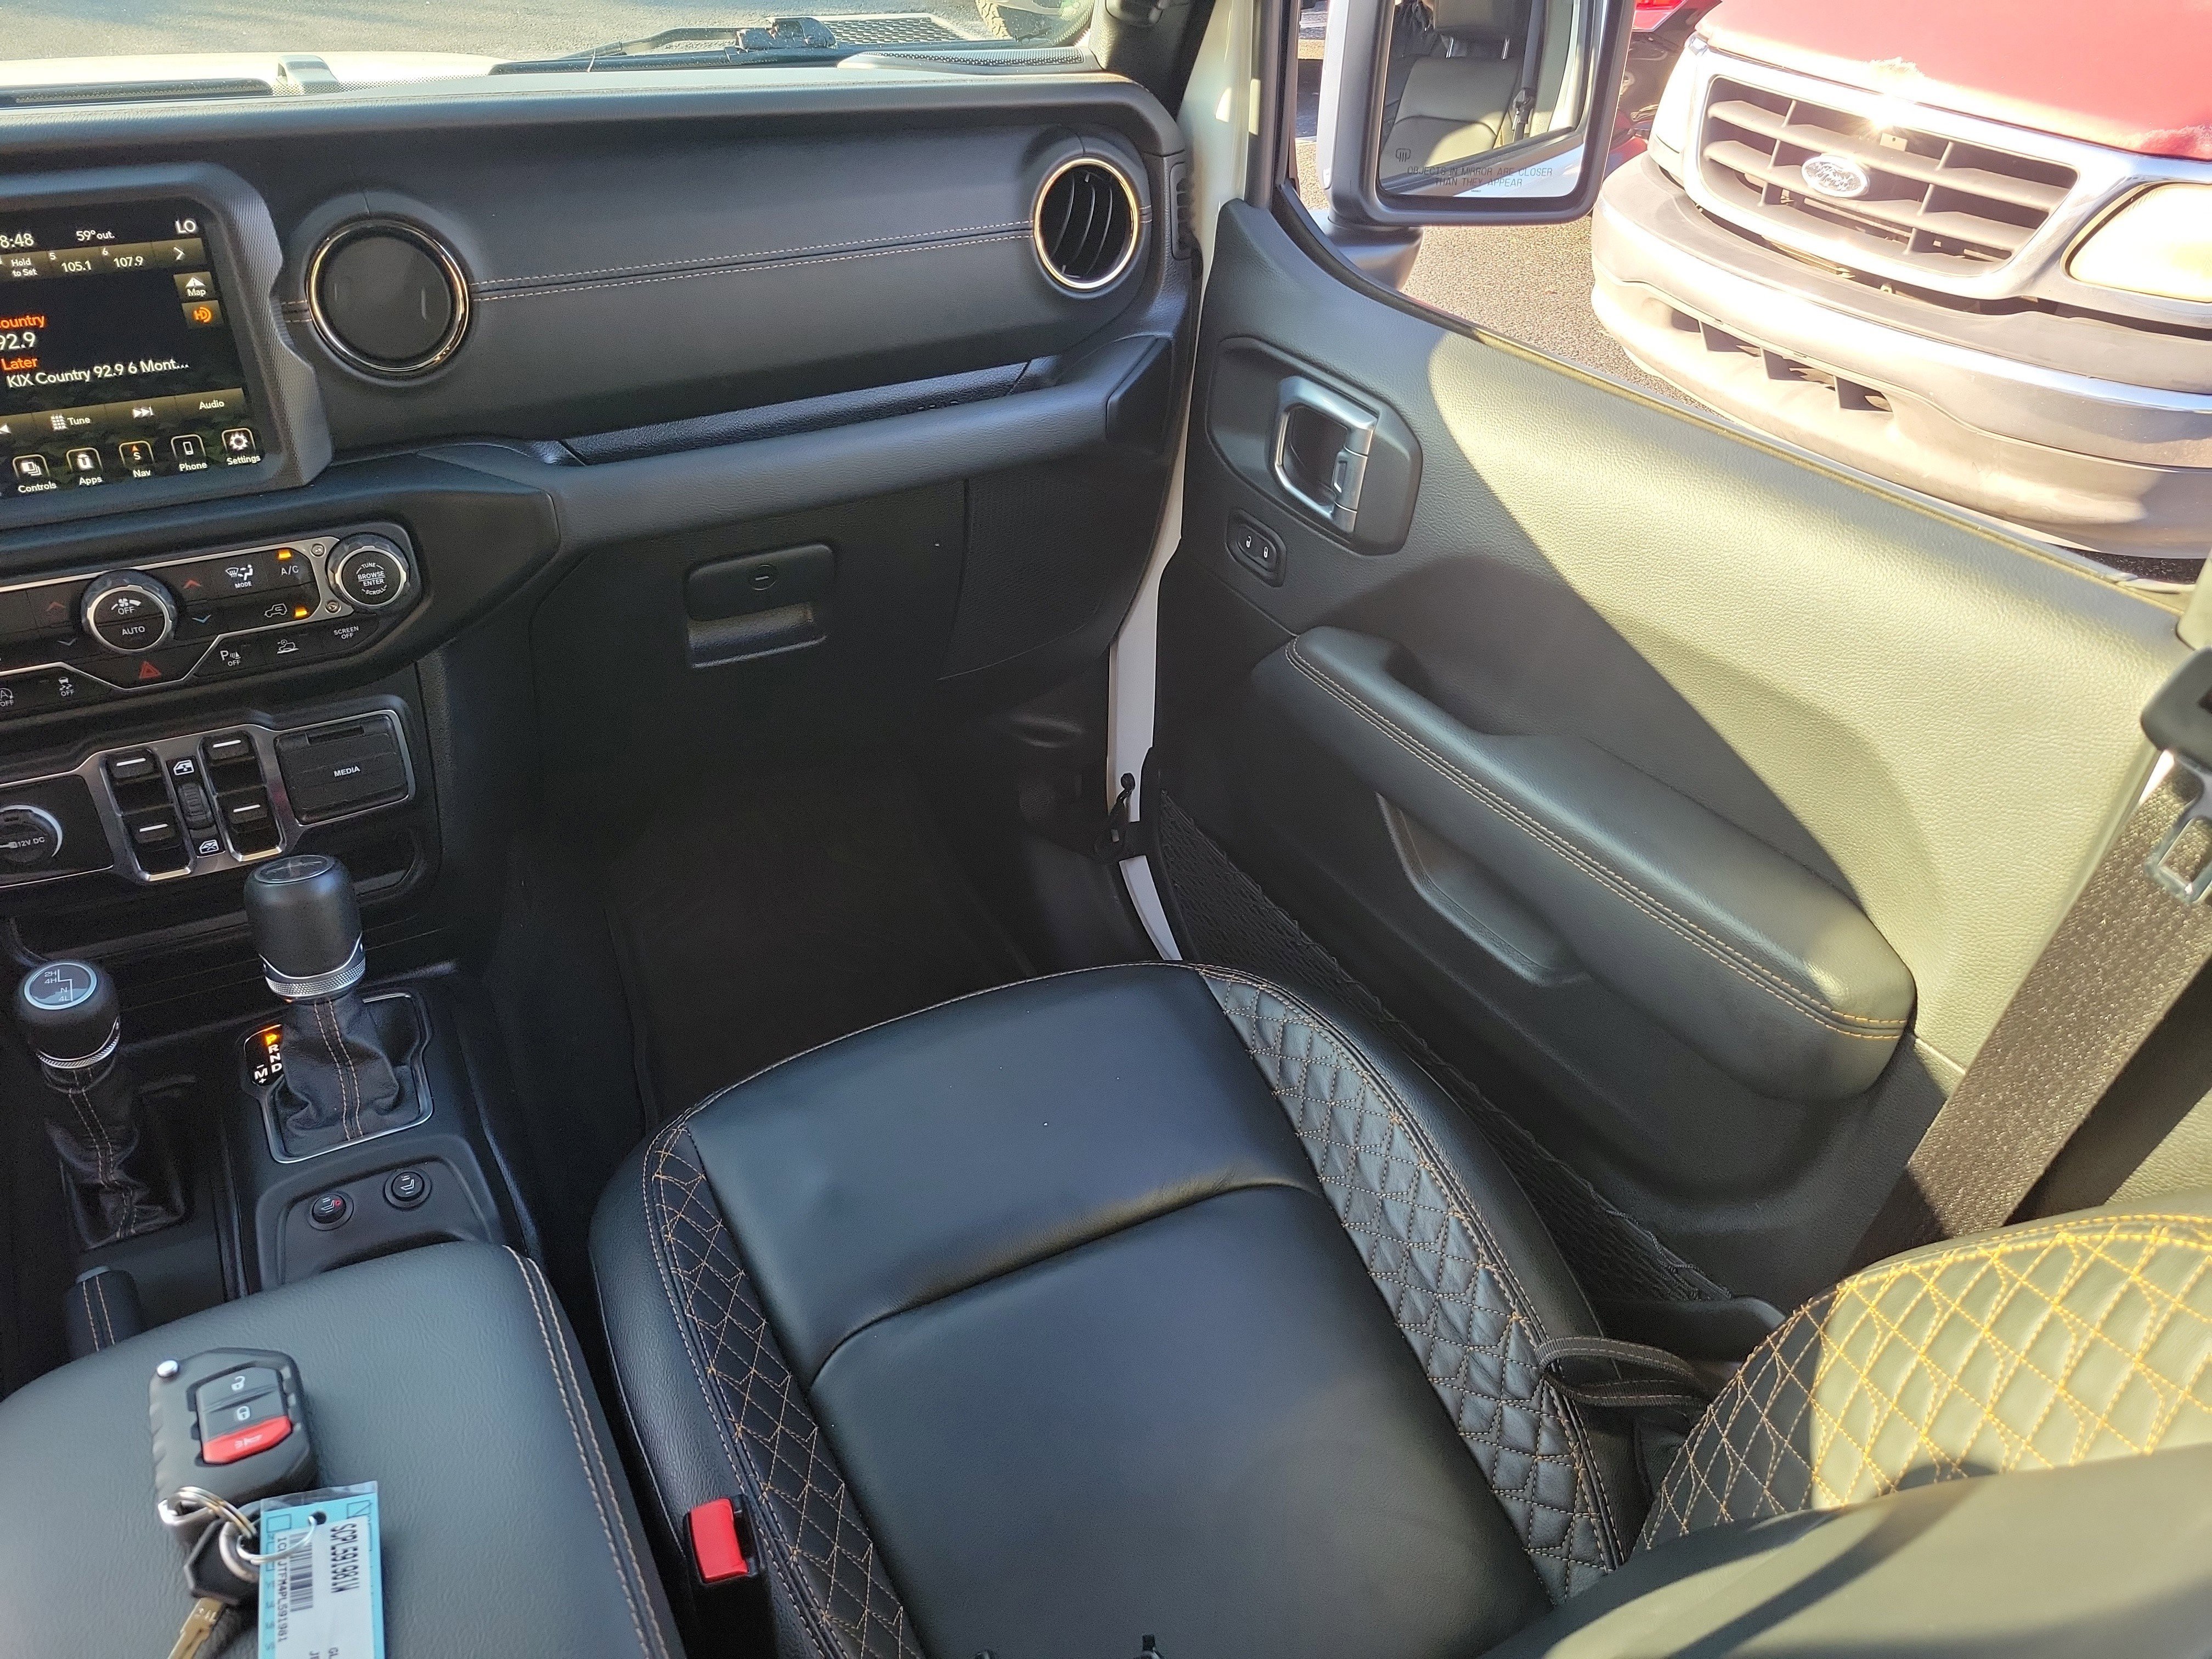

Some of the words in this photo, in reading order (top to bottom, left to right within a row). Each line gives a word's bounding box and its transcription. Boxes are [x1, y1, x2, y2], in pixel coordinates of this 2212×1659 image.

[1407, 166, 1446, 176] OBJECTS
[1450, 167, 1457, 175] IN
[1461, 167, 1492, 176] MIRROR
[1497, 167, 1514, 176] ARE
[1518, 167, 1553, 177] CLOSER
[1435, 177, 1457, 186] THAN
[1462, 177, 1483, 186] THEY
[1487, 178, 1522, 187] APPEAR
[176, 219, 196, 234] LO
[0, 233, 34, 248] 8:48
[102, 247, 109, 256] 6
[11, 258, 31, 267] Hold
[61, 261, 91, 273] 105.1
[114, 256, 143, 268] 107.9
[0, 315, 45, 328] ountry
[1, 358, 38, 371] Later
[7, 374, 34, 388] KIX
[36, 370, 91, 384] Country
[93, 364, 124, 378] 92.9
[128, 362, 137, 374] 6
[199, 399, 224, 410] Audio
[67, 416, 91, 425] Tune
[227, 455, 261, 466] Settings
[179, 461, 207, 472] Phone
[133, 469, 151, 478] Nav
[79, 476, 102, 486] Apps
[18, 482, 57, 494] Controls
[281, 565, 299, 576] A/C
[357, 571, 385, 580] BROWSE
[117, 607, 135, 615] OFF
[122, 626, 145, 636] AUTO
[334, 626, 359, 635] SCREEN
[220, 650, 229, 661] P
[334, 766, 360, 777] MEDIA
[18, 839, 31, 848] 12V
[266, 1034, 277, 1045] P
[268, 1044, 279, 1054] R
[270, 1053, 281, 1063] N
[254, 1068, 268, 1080] M
[272, 1063, 283, 1074] D
